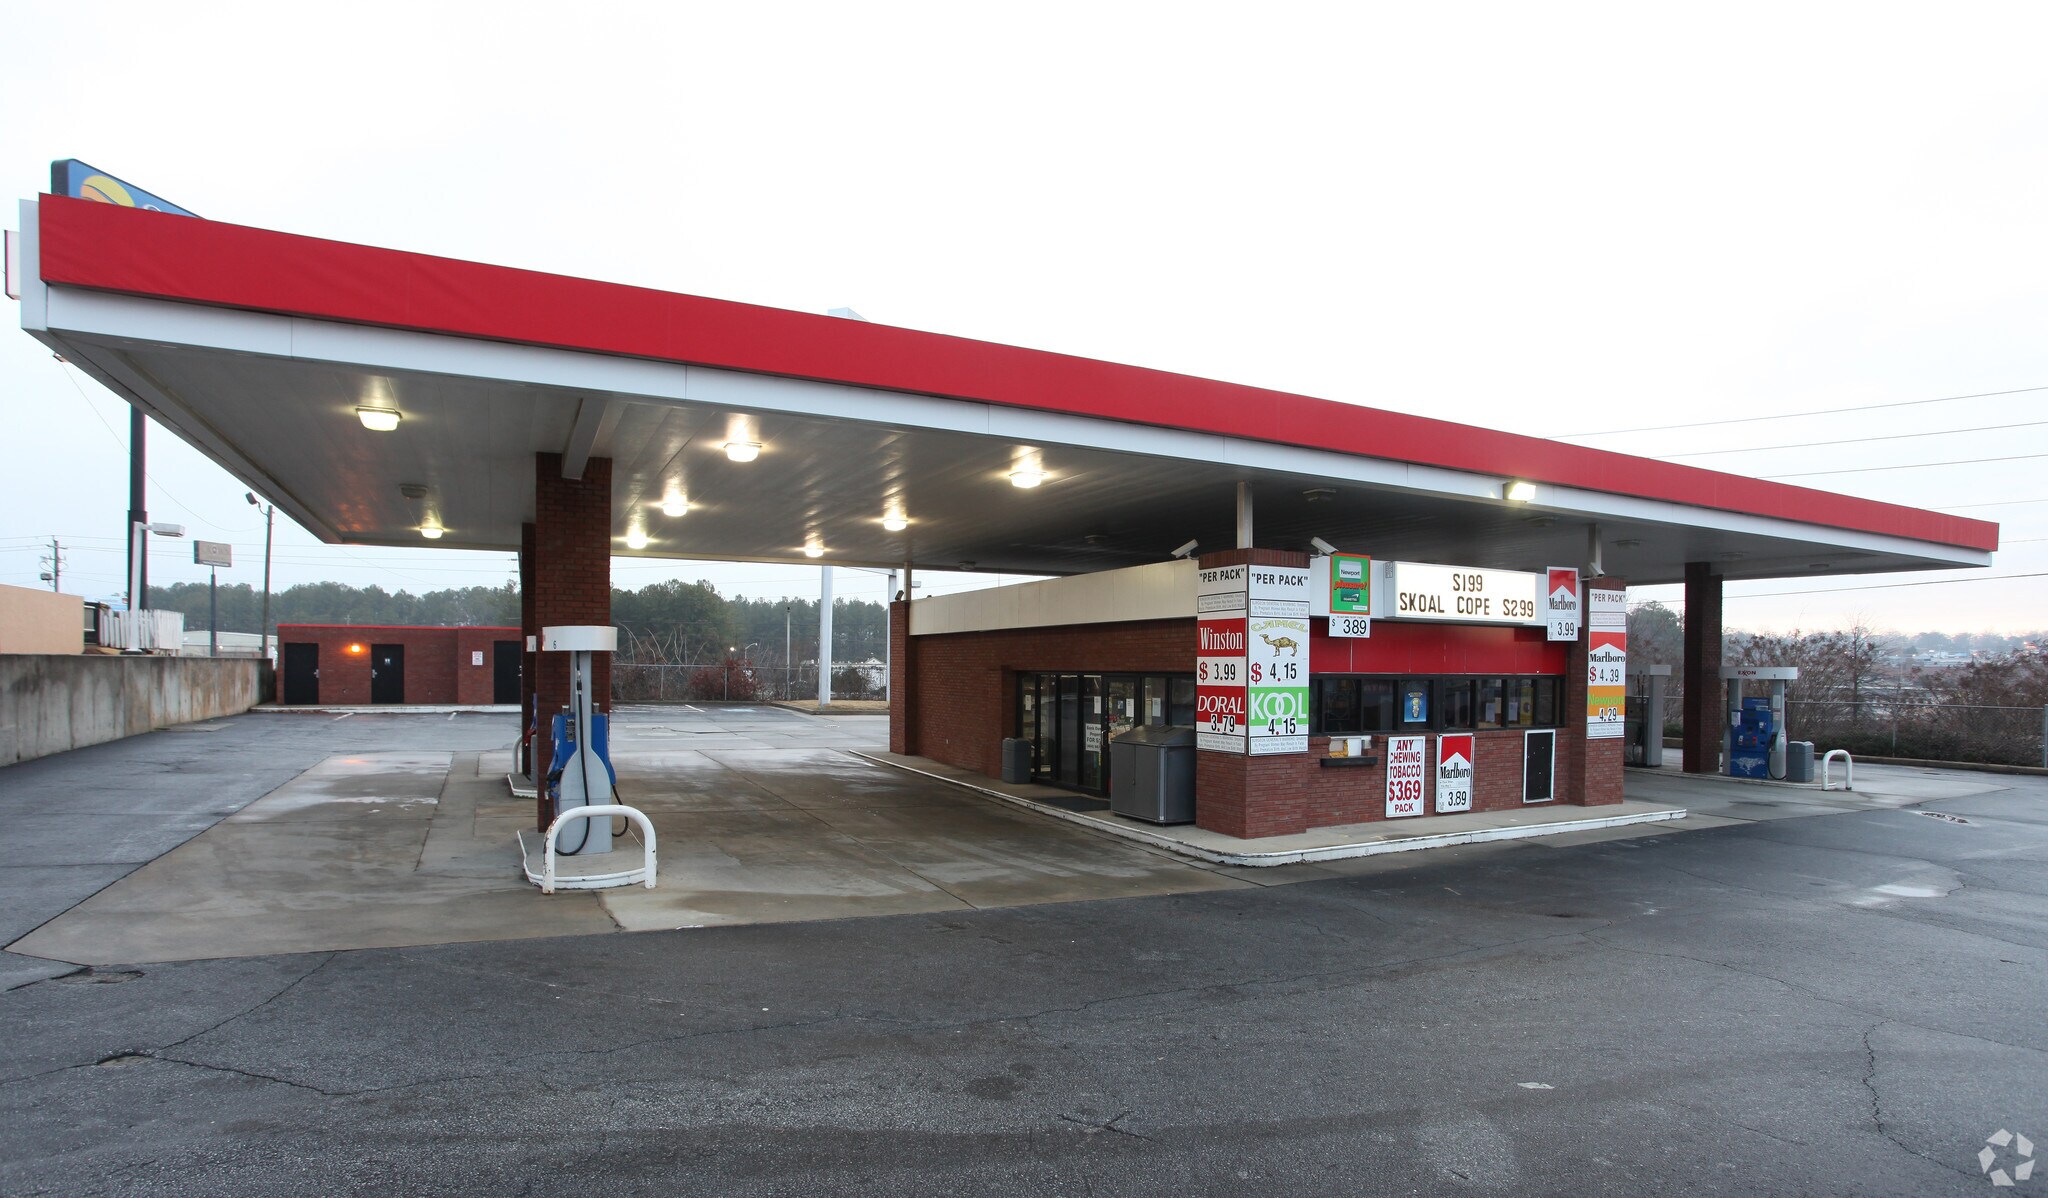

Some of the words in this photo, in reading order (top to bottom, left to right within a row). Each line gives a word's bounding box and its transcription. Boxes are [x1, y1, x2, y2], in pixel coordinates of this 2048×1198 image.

[1199, 571, 1218, 583] "PER
[1220, 568, 1245, 581] PACK"
[1251, 573, 1275, 585] "PER
[1278, 574, 1309, 587] PACK"
[1399, 592, 1445, 613] SKOAL
[1457, 596, 1490, 615] COPE
[1548, 594, 1577, 611] Marlboro
[1591, 593, 1606, 602] "PER
[1607, 593, 1626, 603] PACK"
[1250, 620, 1308, 633] CAMEL
[1331, 618, 1336, 626] $
[1557, 621, 1575, 636] 3.99
[552, 640, 557, 650] 6
[1199, 627, 1243, 650] Winston
[1589, 651, 1626, 663] Marlboro
[1199, 660, 1208, 683] $
[1214, 663, 1236, 681] 3.99
[1250, 661, 1262, 685] $
[1269, 662, 1297, 682] 4.15
[1589, 665, 1597, 684] $
[1599, 668, 1619, 682] 4.39
[1198, 696, 1245, 714] DORAL
[1250, 692, 1307, 720] KOOL
[1599, 707, 1617, 722] 4.29
[1211, 714, 1235, 733] 3.79
[1268, 717, 1296, 736] 4.15
[1396, 740, 1414, 752] ANY
[1390, 764, 1421, 779] TOBACCO
[1440, 762, 1471, 779] Marlboro
[1448, 790, 1467, 807] 3.89
[1394, 803, 1414, 813] PACK
